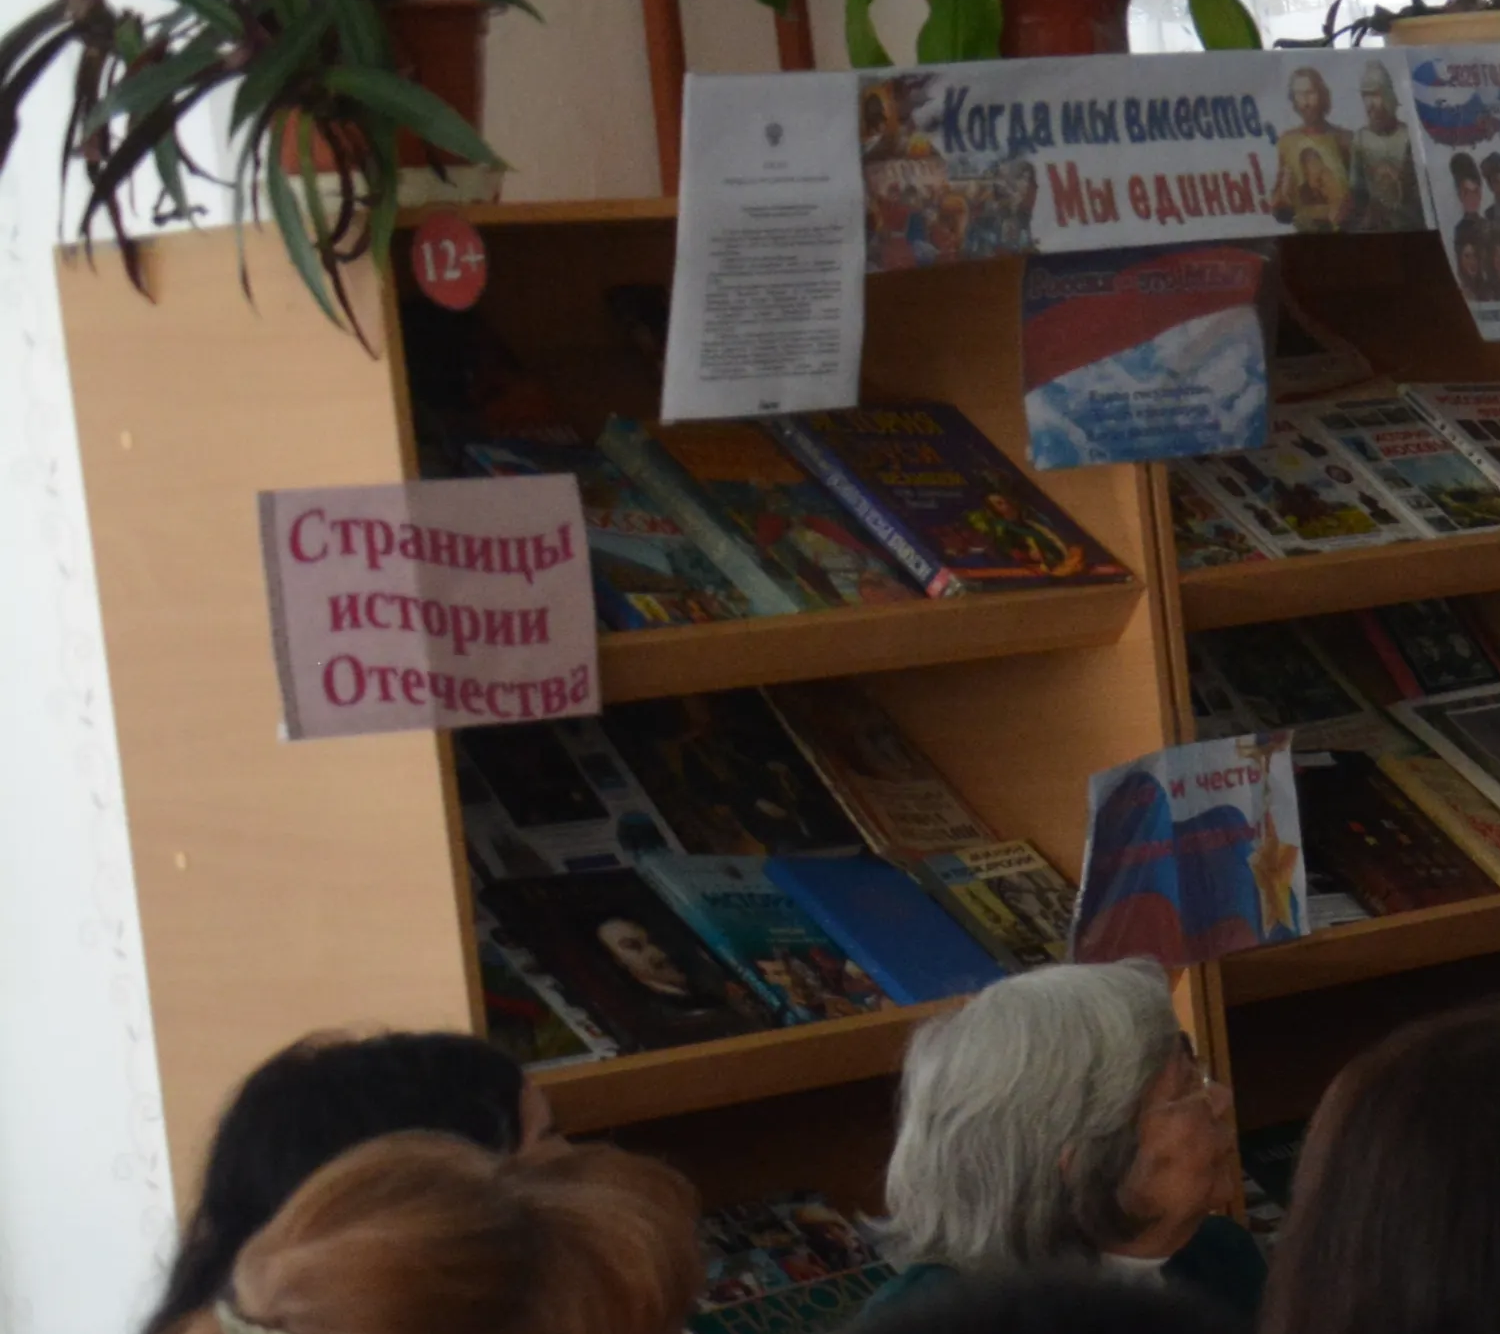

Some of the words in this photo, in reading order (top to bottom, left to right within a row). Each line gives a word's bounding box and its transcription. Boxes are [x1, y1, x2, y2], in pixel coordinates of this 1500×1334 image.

[941, 86, 1053, 154] Когда
[1060, 100, 1119, 146] мы
[1123, 93, 1278, 145] вместе,
[1047, 160, 1119, 228] Мы
[1129, 152, 1271, 225] едины!
[420, 239, 486, 284] 12+
[288, 508, 576, 585] Страницы
[328, 591, 550, 656] истории
[321, 654, 590, 718] Отечества
[1169, 779, 1187, 800] и
[1194, 764, 1262, 794] честь
